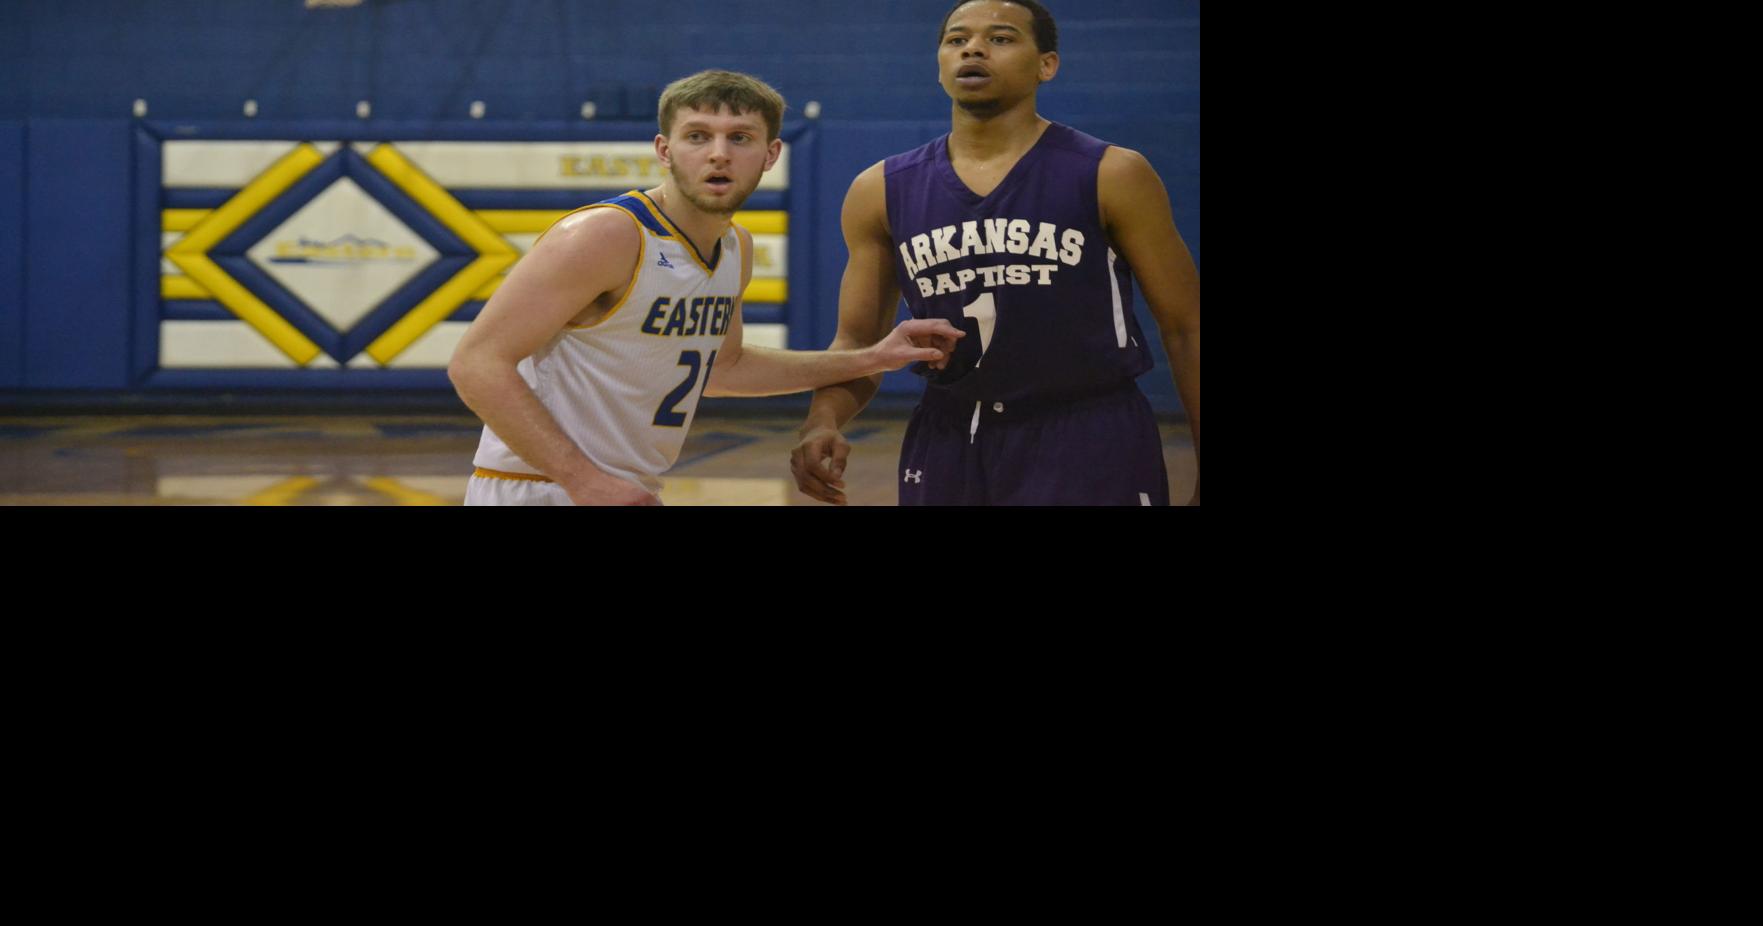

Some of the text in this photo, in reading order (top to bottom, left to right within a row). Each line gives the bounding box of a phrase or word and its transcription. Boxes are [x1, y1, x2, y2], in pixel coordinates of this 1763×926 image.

[899, 218, 1085, 281] ARKANSAS
[916, 264, 1059, 298] BAPTIST
[963, 292, 997, 368] 1
